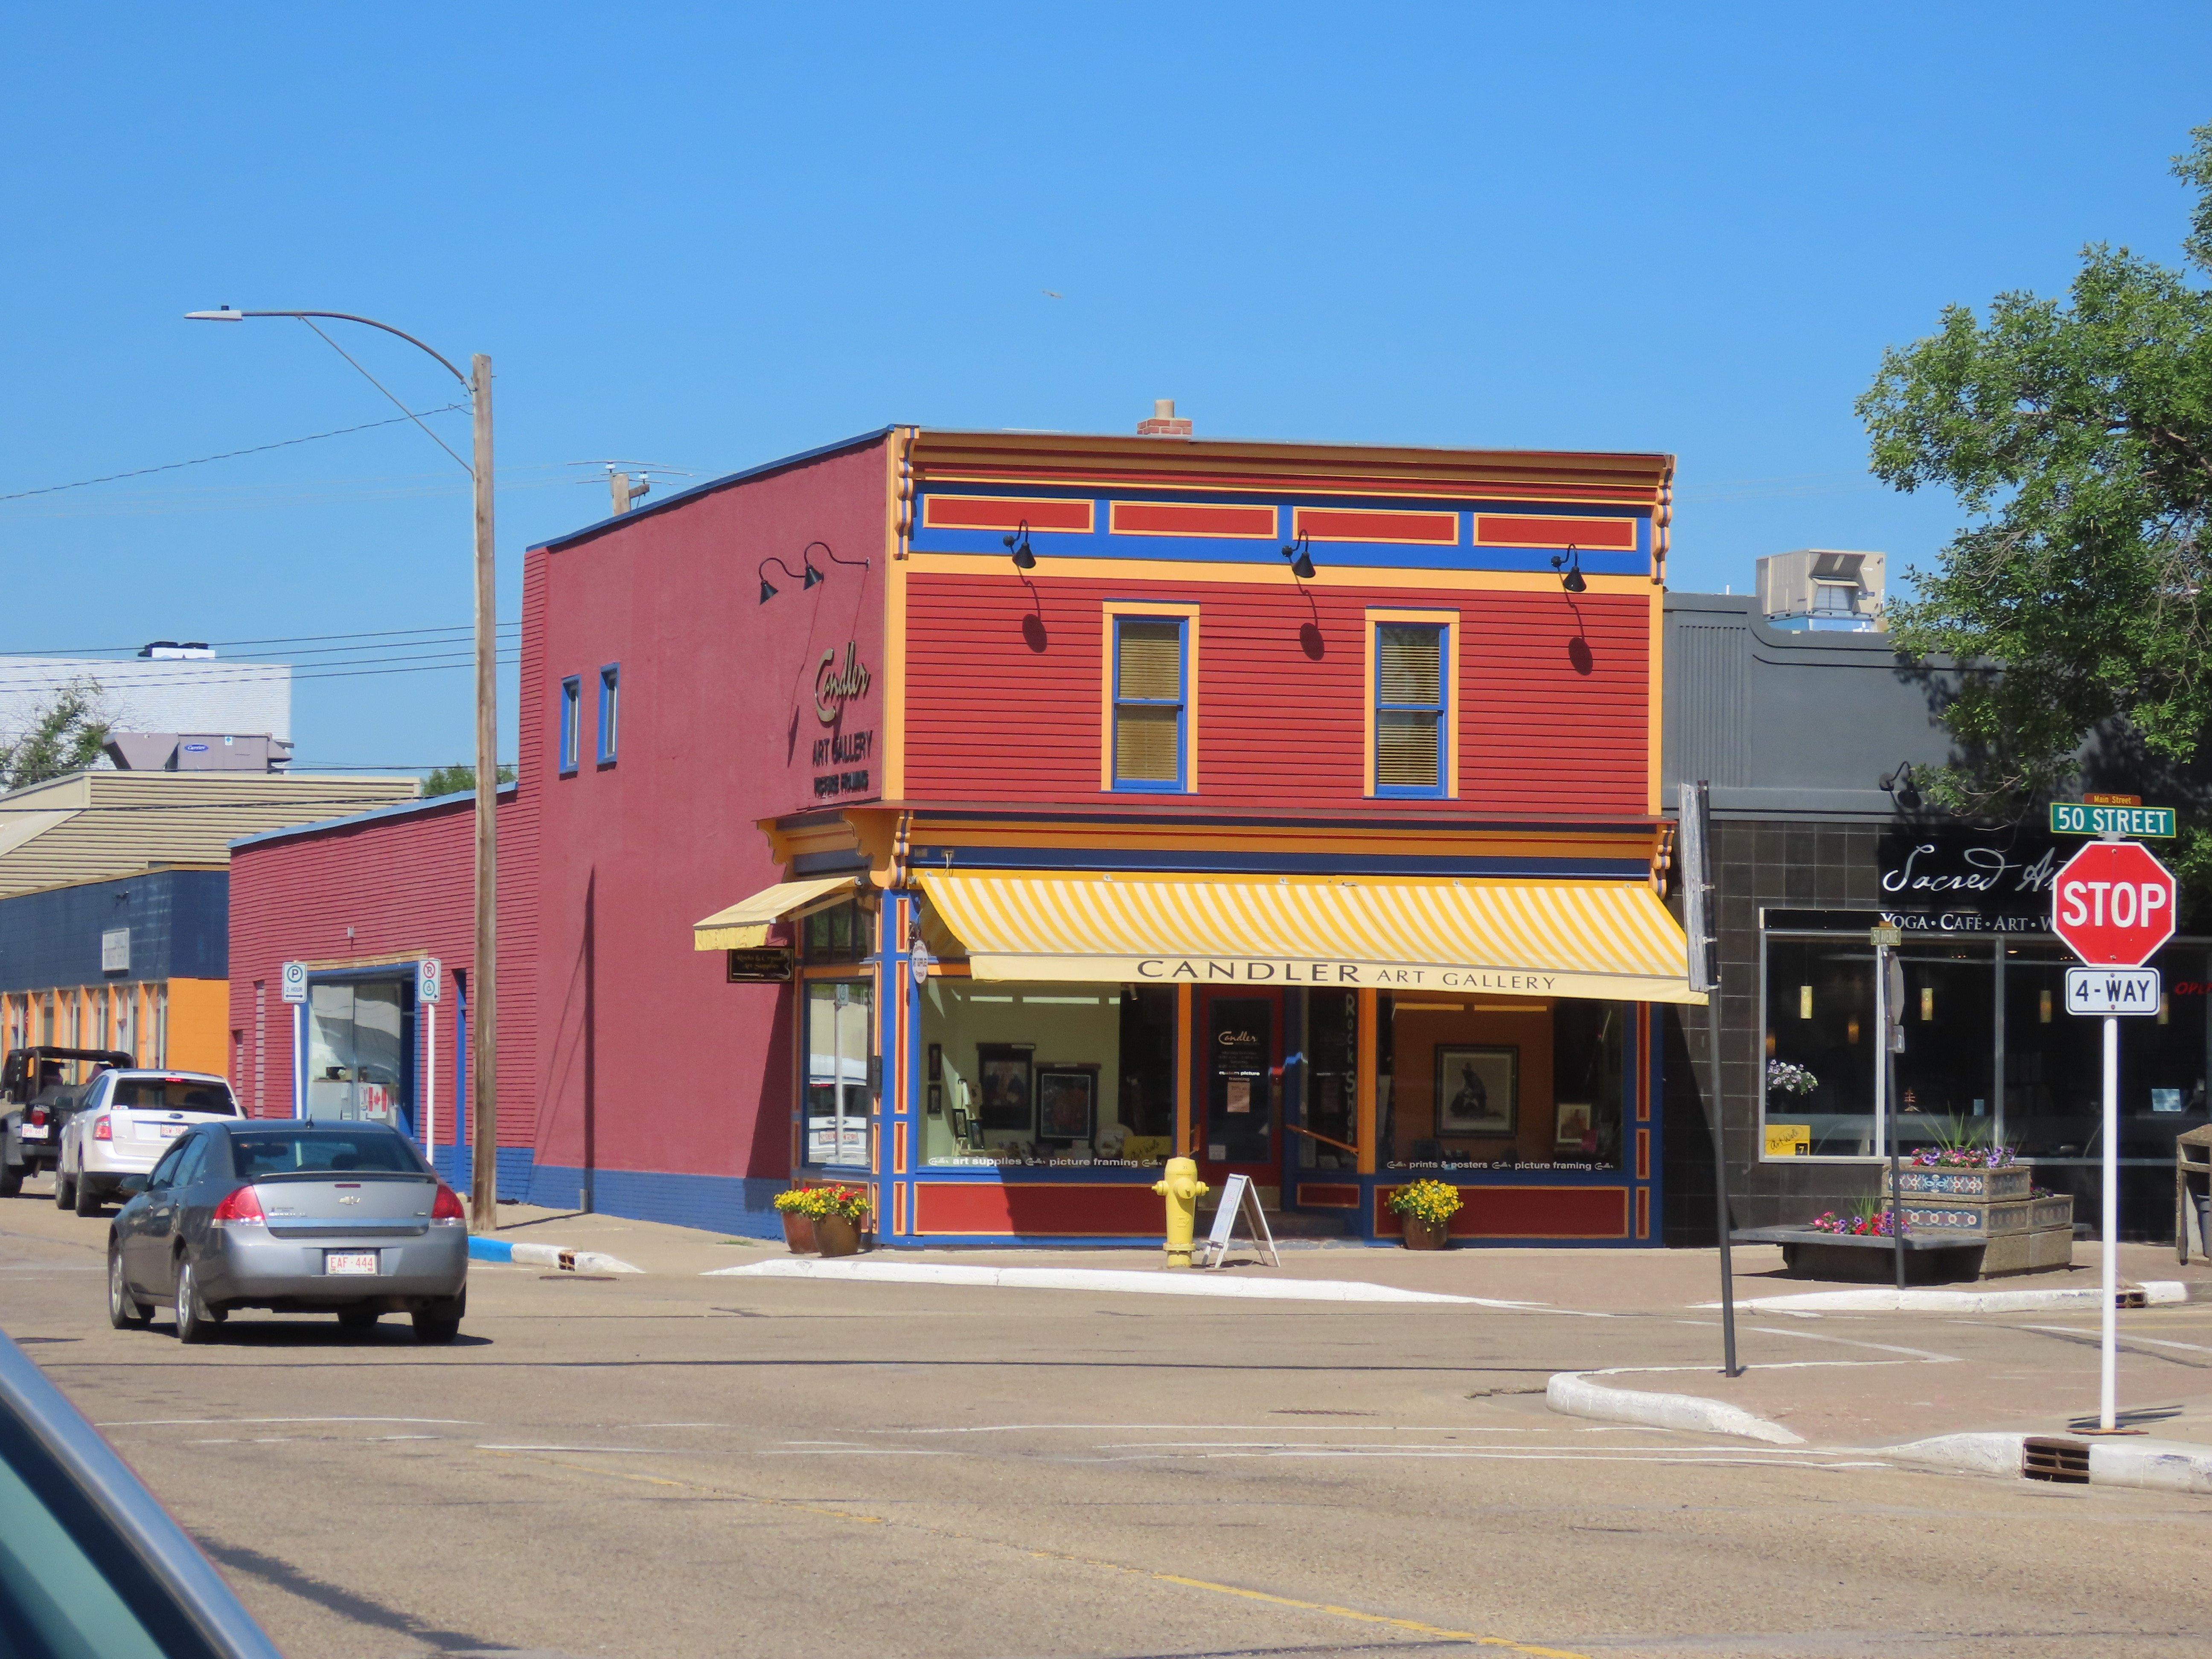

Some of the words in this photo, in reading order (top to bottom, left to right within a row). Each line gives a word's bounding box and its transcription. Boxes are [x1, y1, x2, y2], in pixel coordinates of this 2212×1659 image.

[812, 738, 830, 766] ART
[832, 730, 873, 764] GALLERY
[2094, 795, 2109, 803] Main
[2112, 796, 2131, 804] Street
[2058, 807, 2085, 830] 50
[2093, 809, 2167, 833] STREET
[1883, 844, 2022, 892] Sacred
[2062, 881, 2166, 928] STOP
[1994, 916, 2028, 931] ART
[1137, 960, 1361, 983] CANDLER
[1377, 969, 1425, 984] ART
[1442, 972, 1556, 990] GALLERY
[1219, 1031, 1257, 1045] Candler
[1799, 1146, 1805, 1154] 7
[972, 1156, 1022, 1167] supplies
[1049, 1158, 1091, 1167] picture
[1094, 1158, 1138, 1168] framing
[1409, 1160, 1438, 1169] prints
[1441, 1161, 1448, 1169] &
[1451, 1161, 1488, 1170] posters
[1515, 1161, 1550, 1170] picture
[1553, 1161, 1592, 1171] framing
